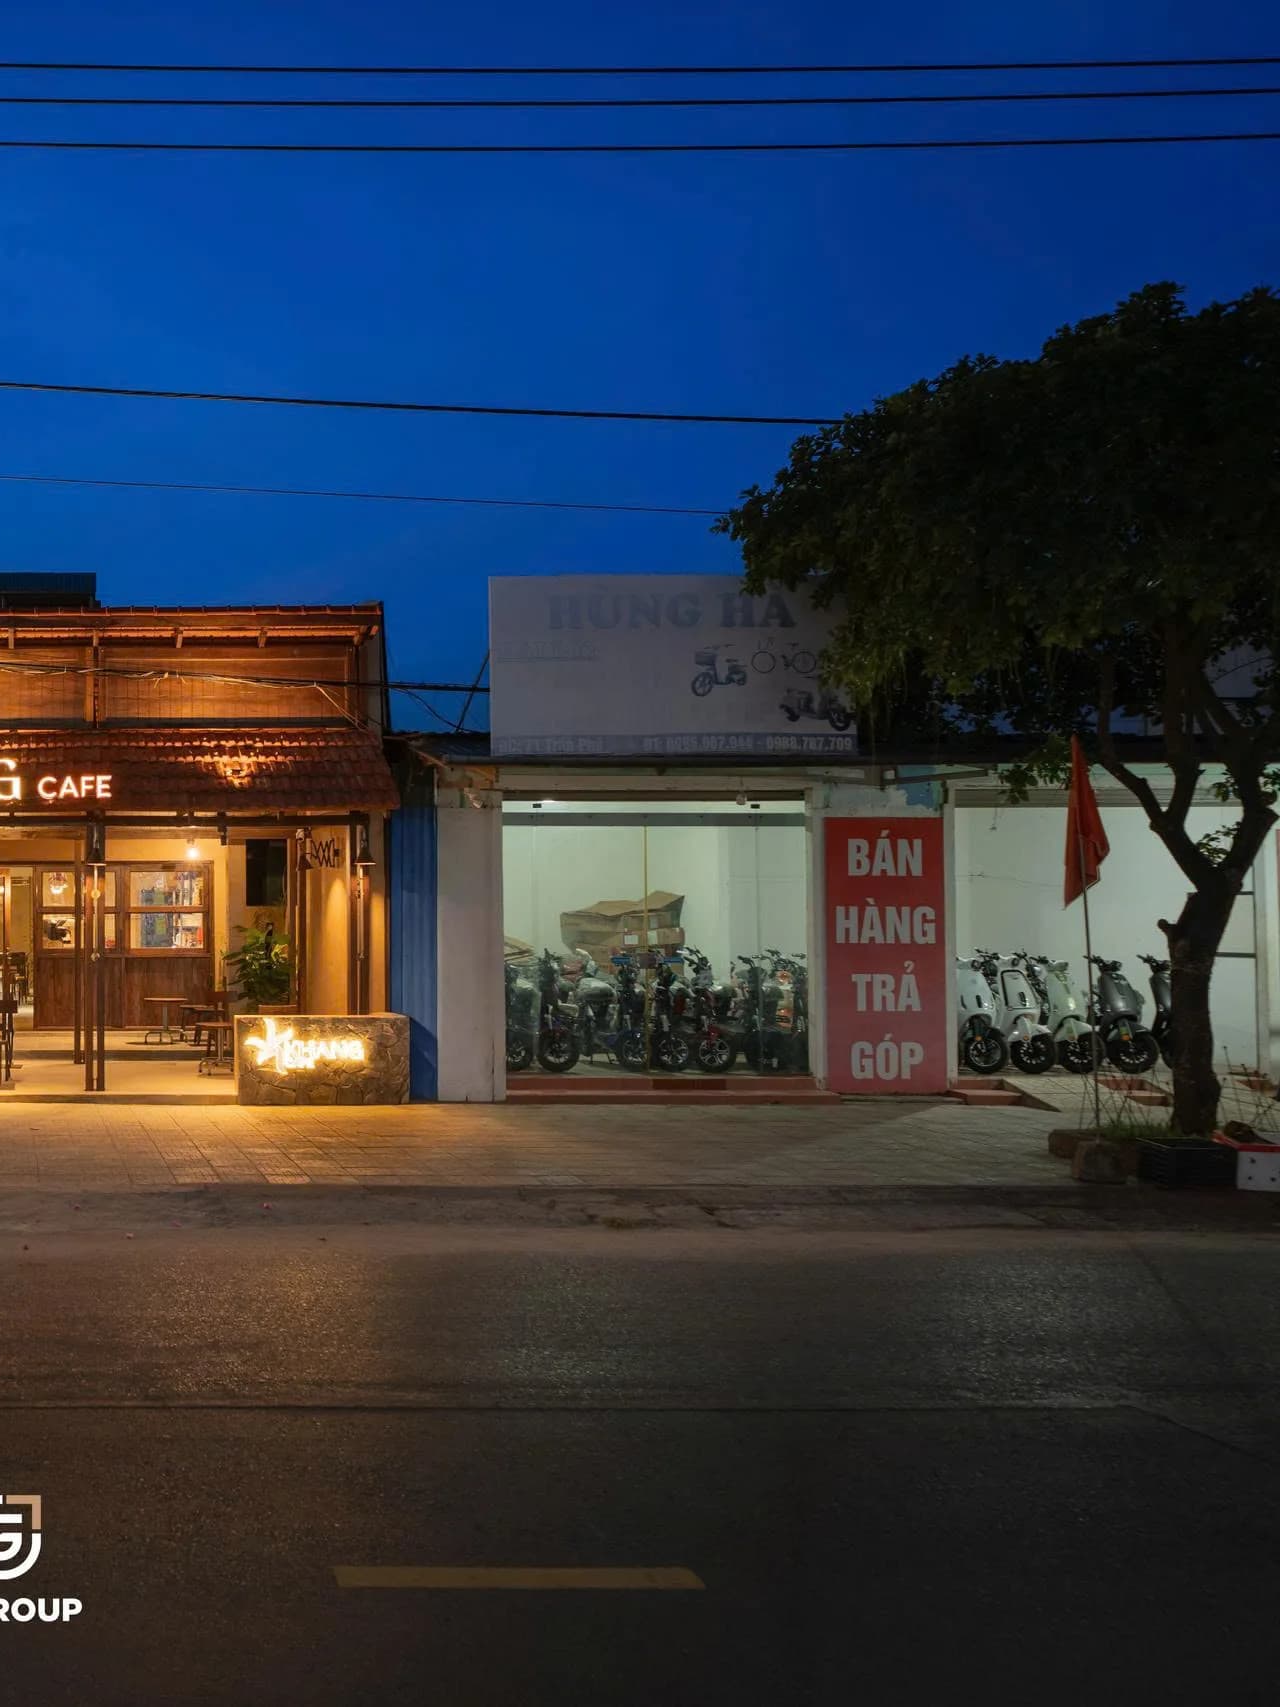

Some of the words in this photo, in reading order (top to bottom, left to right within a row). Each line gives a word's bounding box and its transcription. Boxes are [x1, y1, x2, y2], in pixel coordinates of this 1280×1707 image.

[36, 774, 112, 798] CAFE
[847, 829, 924, 877] BÁN
[835, 897, 937, 944] HÀNG
[851, 960, 922, 1012] TRẢ
[850, 1033, 925, 1080] GÓP
